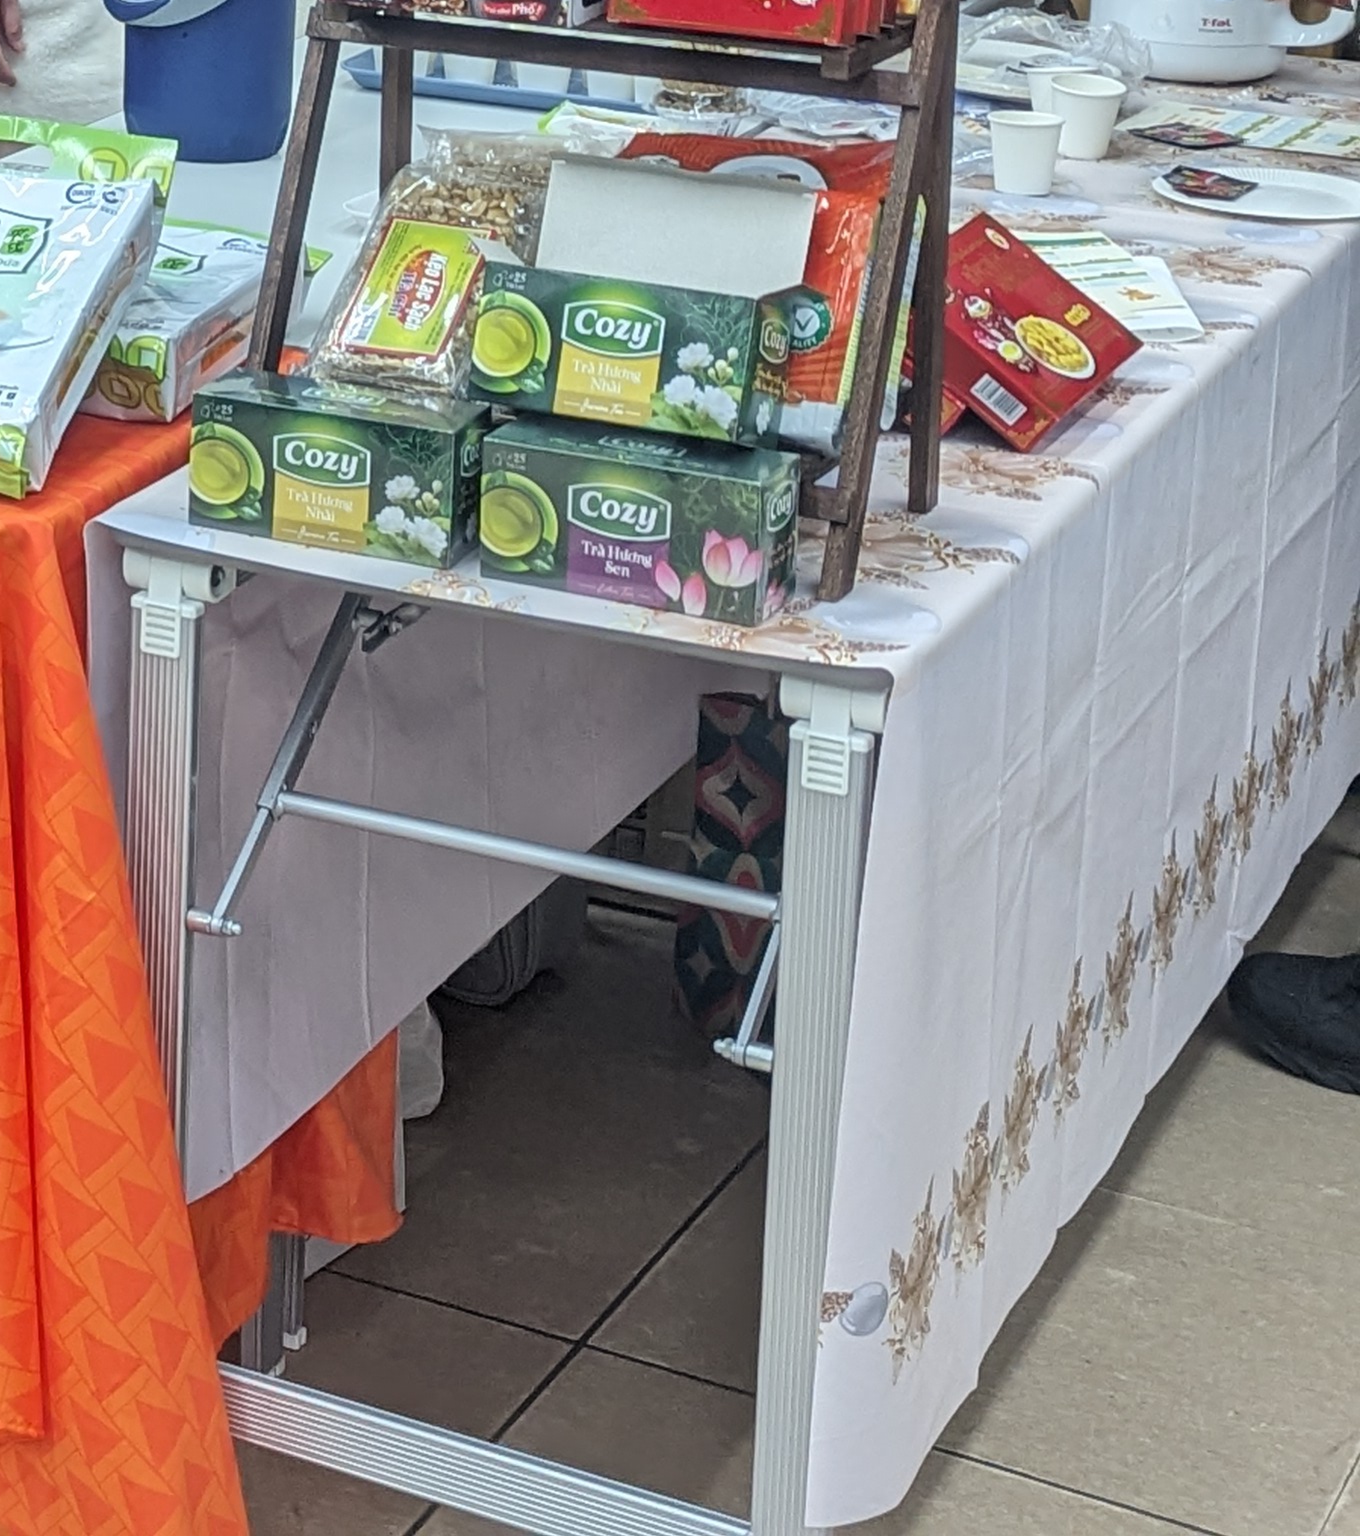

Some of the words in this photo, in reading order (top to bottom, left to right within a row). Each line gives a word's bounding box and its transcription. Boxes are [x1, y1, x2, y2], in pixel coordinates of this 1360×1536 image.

[575, 308, 651, 350] Cozy
[764, 324, 787, 356] Cozy
[792, 337, 818, 348] ALITY
[572, 358, 595, 374] Trà
[284, 440, 359, 480] Cozy
[286, 487, 309, 502] Trà
[580, 490, 657, 533] Cozy
[581, 540, 605, 558] Trà
[607, 544, 653, 569] Hương
[604, 561, 630, 578] Sen
